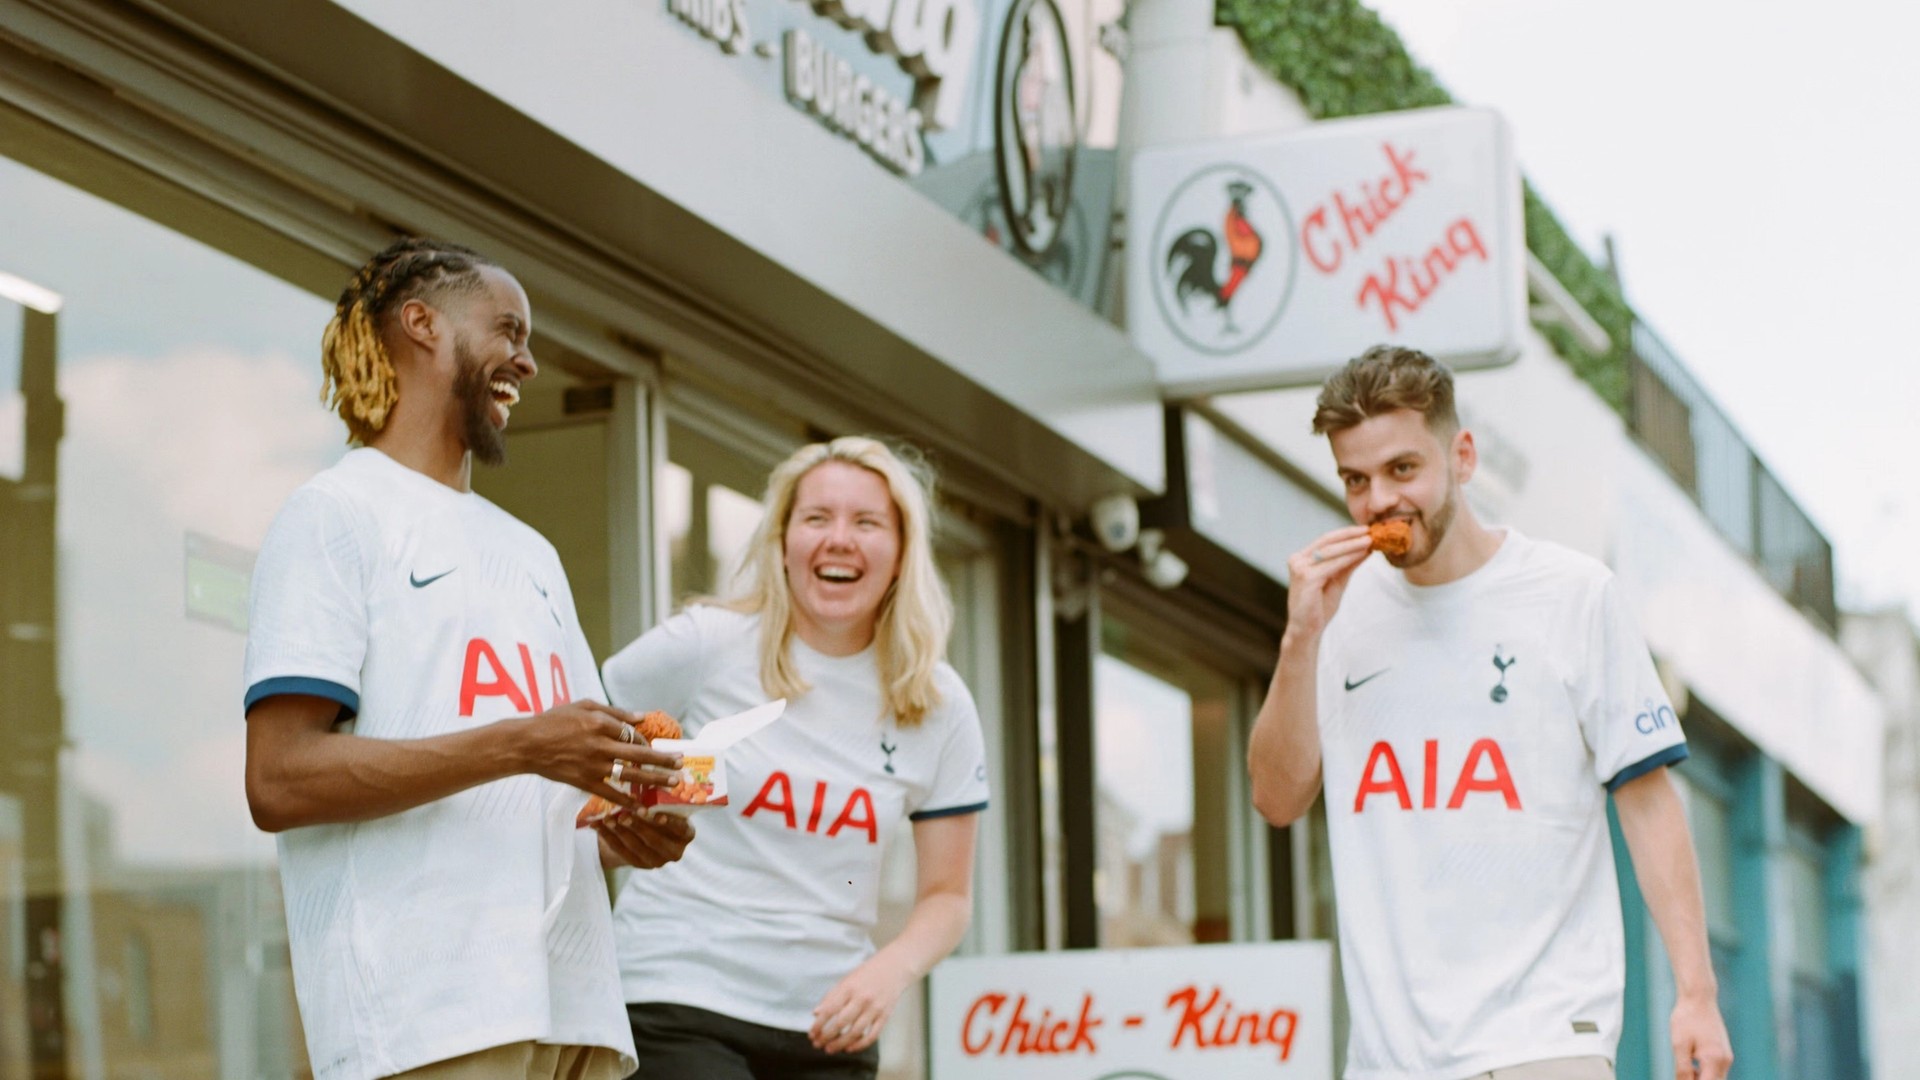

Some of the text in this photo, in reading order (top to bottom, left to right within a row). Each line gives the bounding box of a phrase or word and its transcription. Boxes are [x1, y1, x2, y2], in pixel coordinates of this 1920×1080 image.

[785, 27, 926, 176] BURGERS
[1301, 142, 1430, 274] Chick
[1356, 215, 1488, 332] King
[458, 637, 571, 717] AIA
[741, 770, 878, 845] AIA
[1354, 737, 1523, 813] AIA
[960, 990, 1102, 1056] Chick
[1166, 985, 1299, 1062] King
